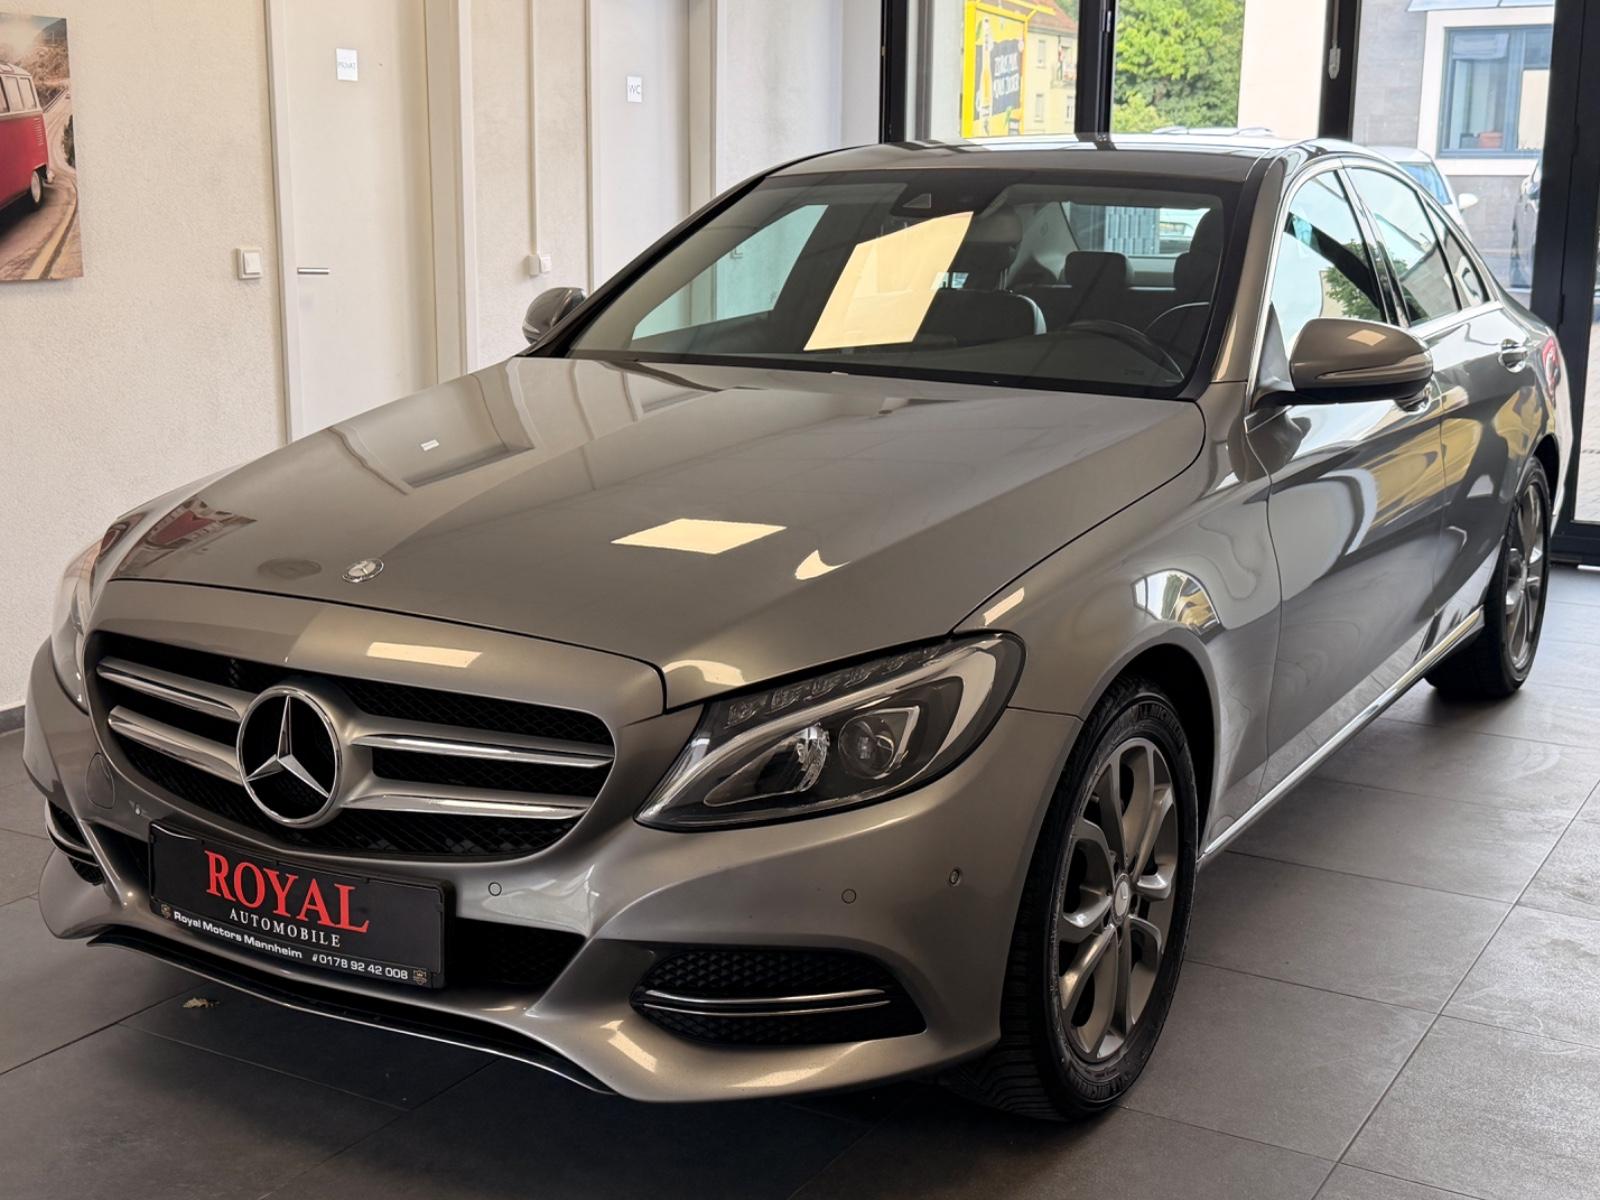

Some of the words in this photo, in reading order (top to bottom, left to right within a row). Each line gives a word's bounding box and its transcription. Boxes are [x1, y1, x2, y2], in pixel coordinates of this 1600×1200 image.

[629, 84, 641, 95] WC
[204, 850, 369, 933] ROYAL
[174, 911, 201, 928] Royal
[203, 921, 242, 942] Motors
[243, 935, 303, 959] Mannheim
[350, 960, 365, 972] 92
[367, 964, 383, 975] 42
[385, 967, 408, 980] 008
[229, 908, 341, 948] AUTOMOBILE
